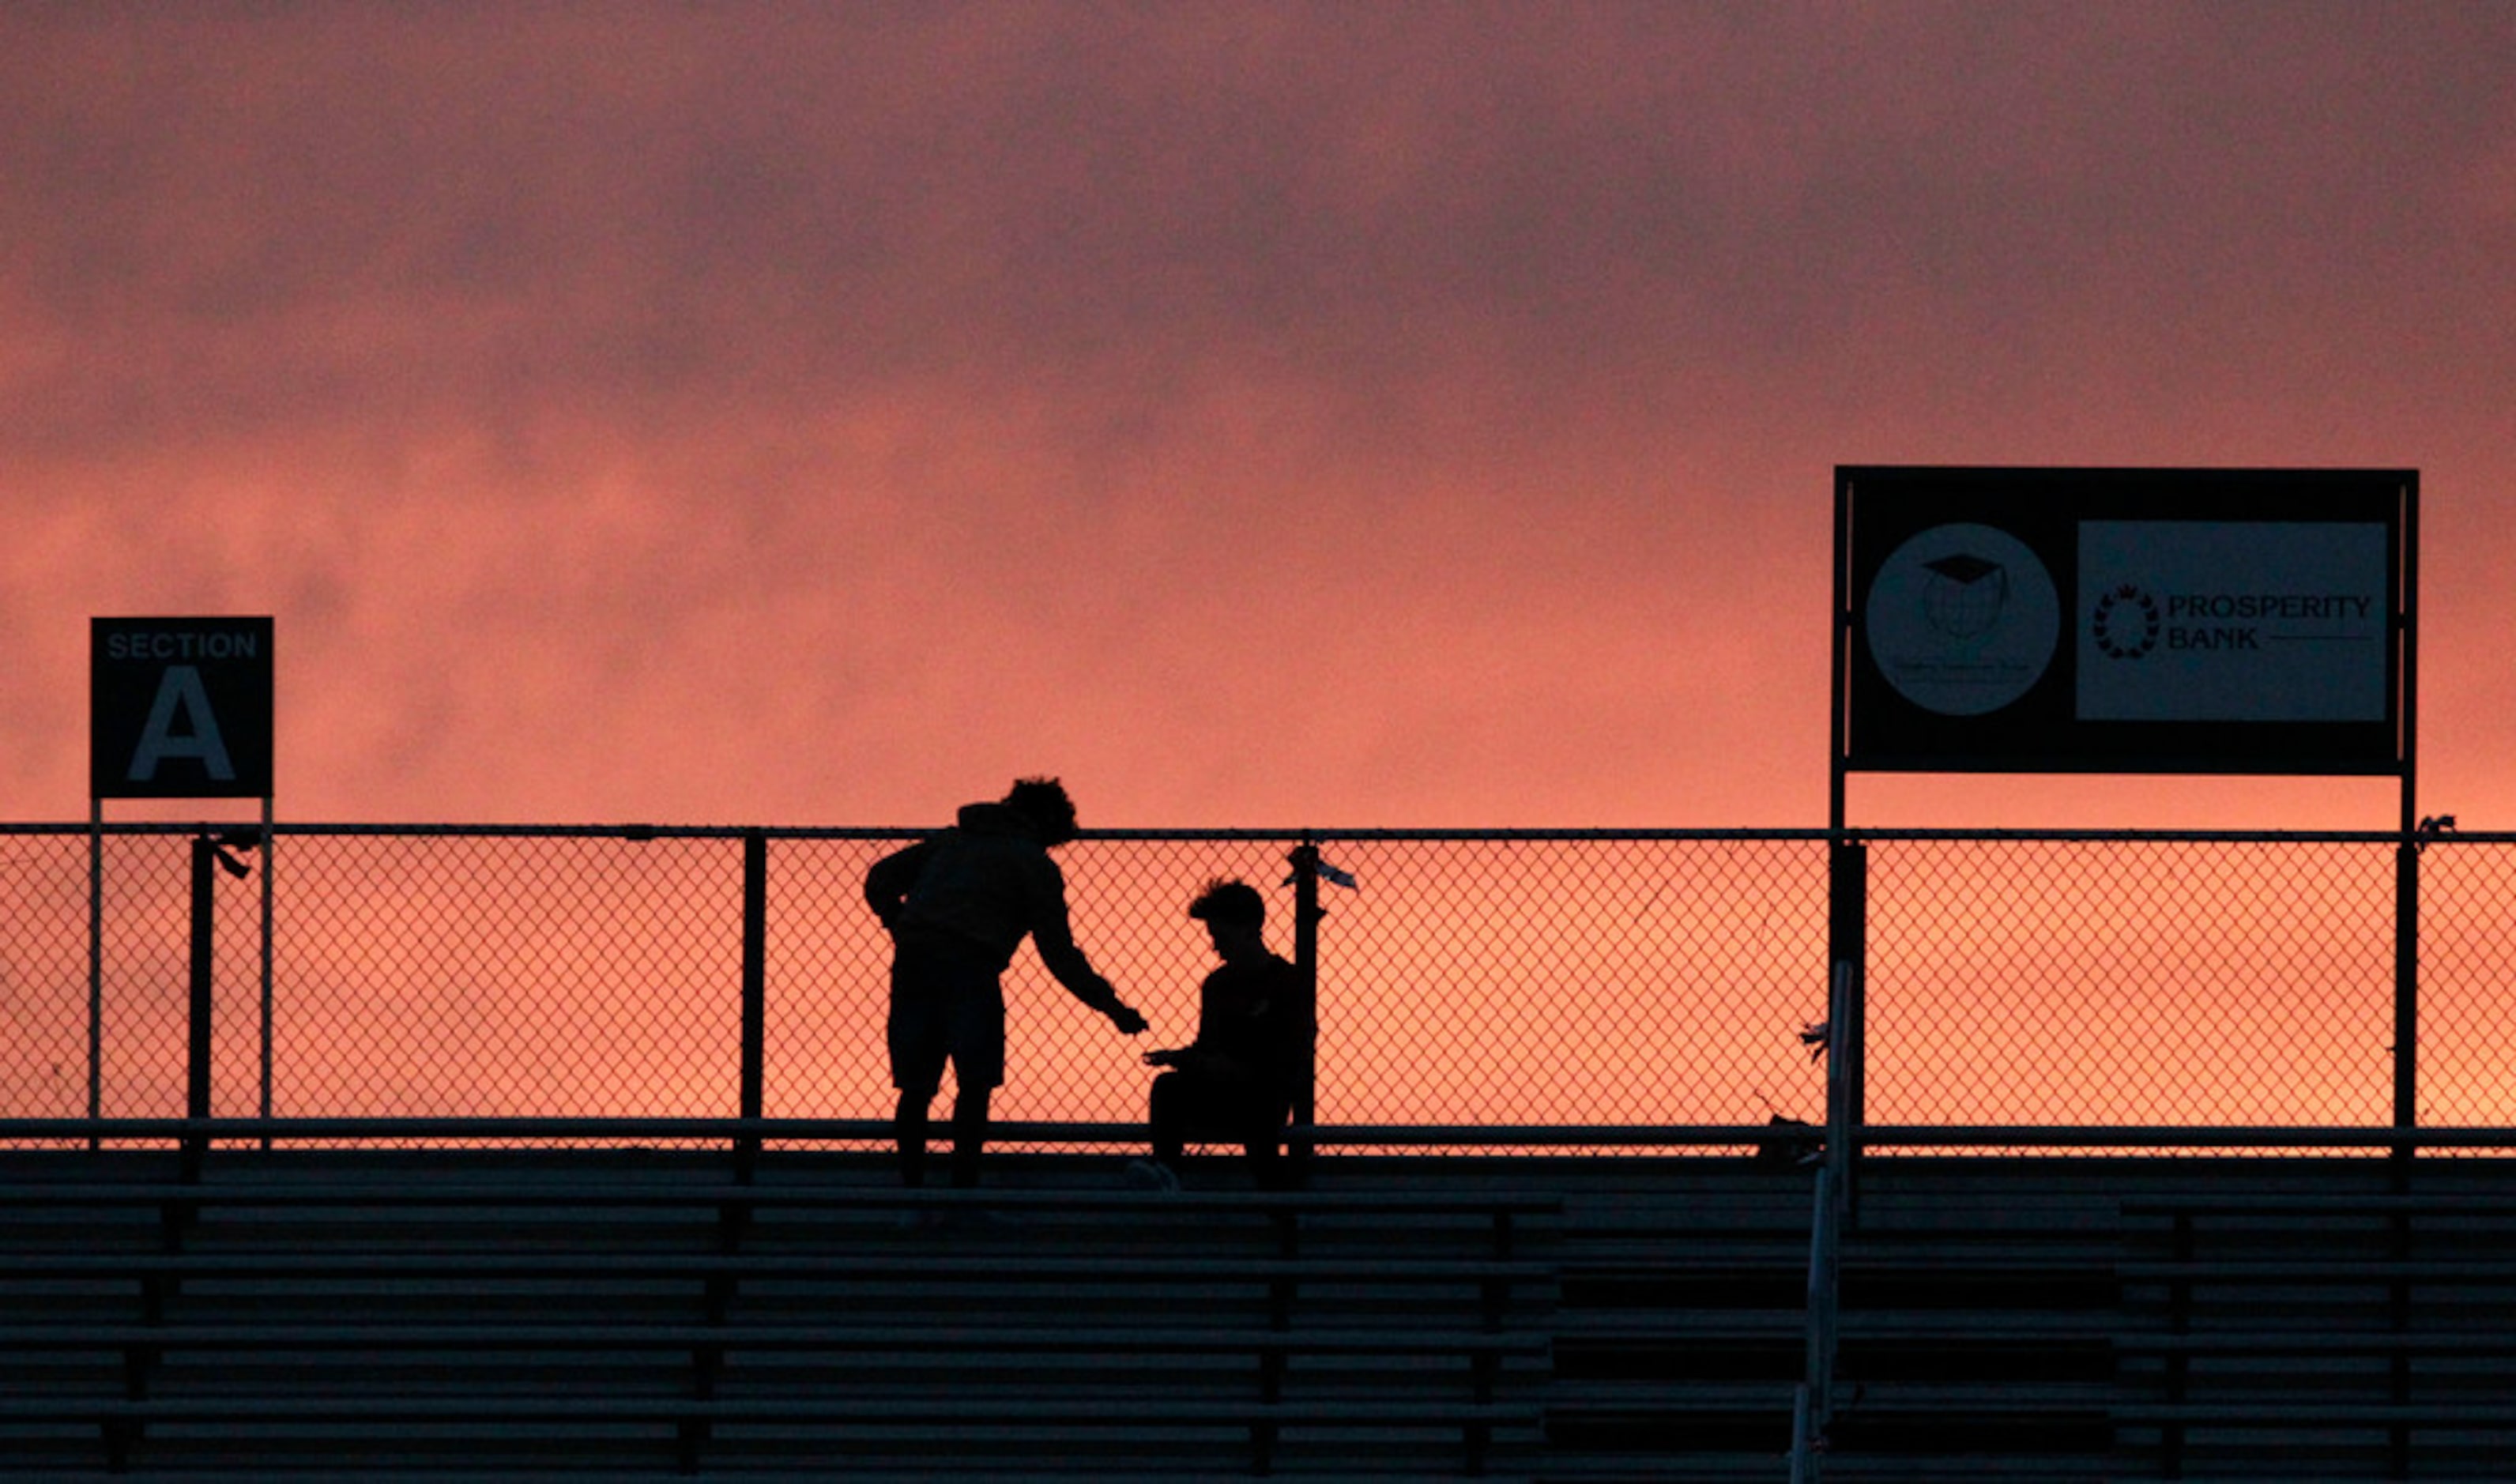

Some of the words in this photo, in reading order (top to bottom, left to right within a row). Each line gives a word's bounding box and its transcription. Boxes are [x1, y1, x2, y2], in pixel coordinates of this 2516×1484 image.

[2169, 595, 2370, 618] PROSPERITY
[108, 633, 257, 659] SECTION
[2169, 627, 2258, 650] BANK
[128, 665, 236, 780] A
